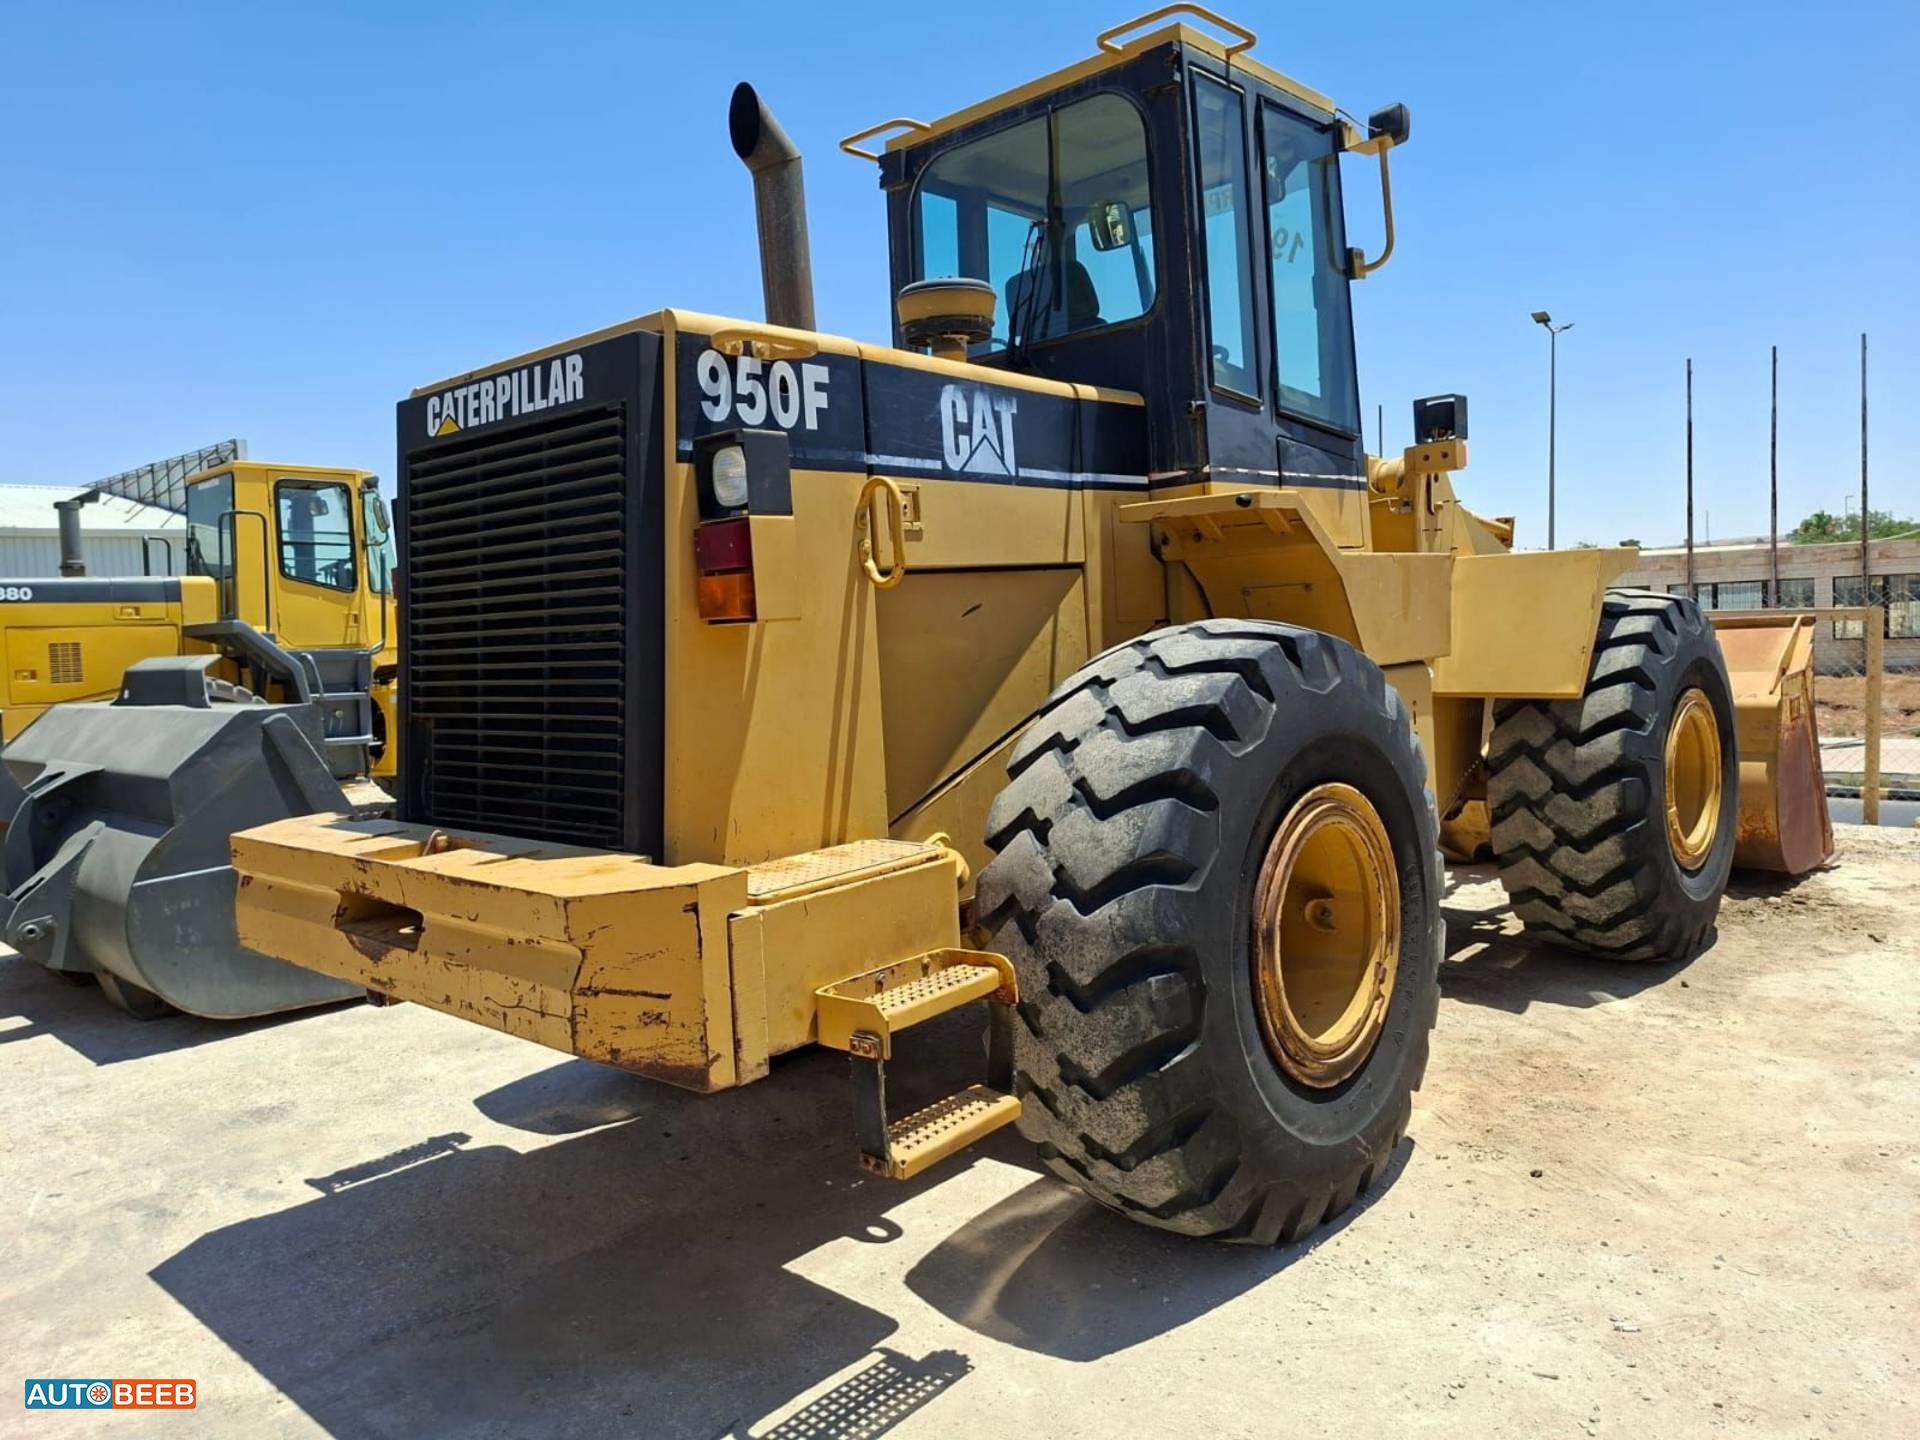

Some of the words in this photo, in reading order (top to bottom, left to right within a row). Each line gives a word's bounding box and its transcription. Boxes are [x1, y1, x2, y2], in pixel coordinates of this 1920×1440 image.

[426, 354, 584, 438] CATERPILLAR
[697, 349, 829, 430] 950F
[940, 384, 1017, 476] CAT
